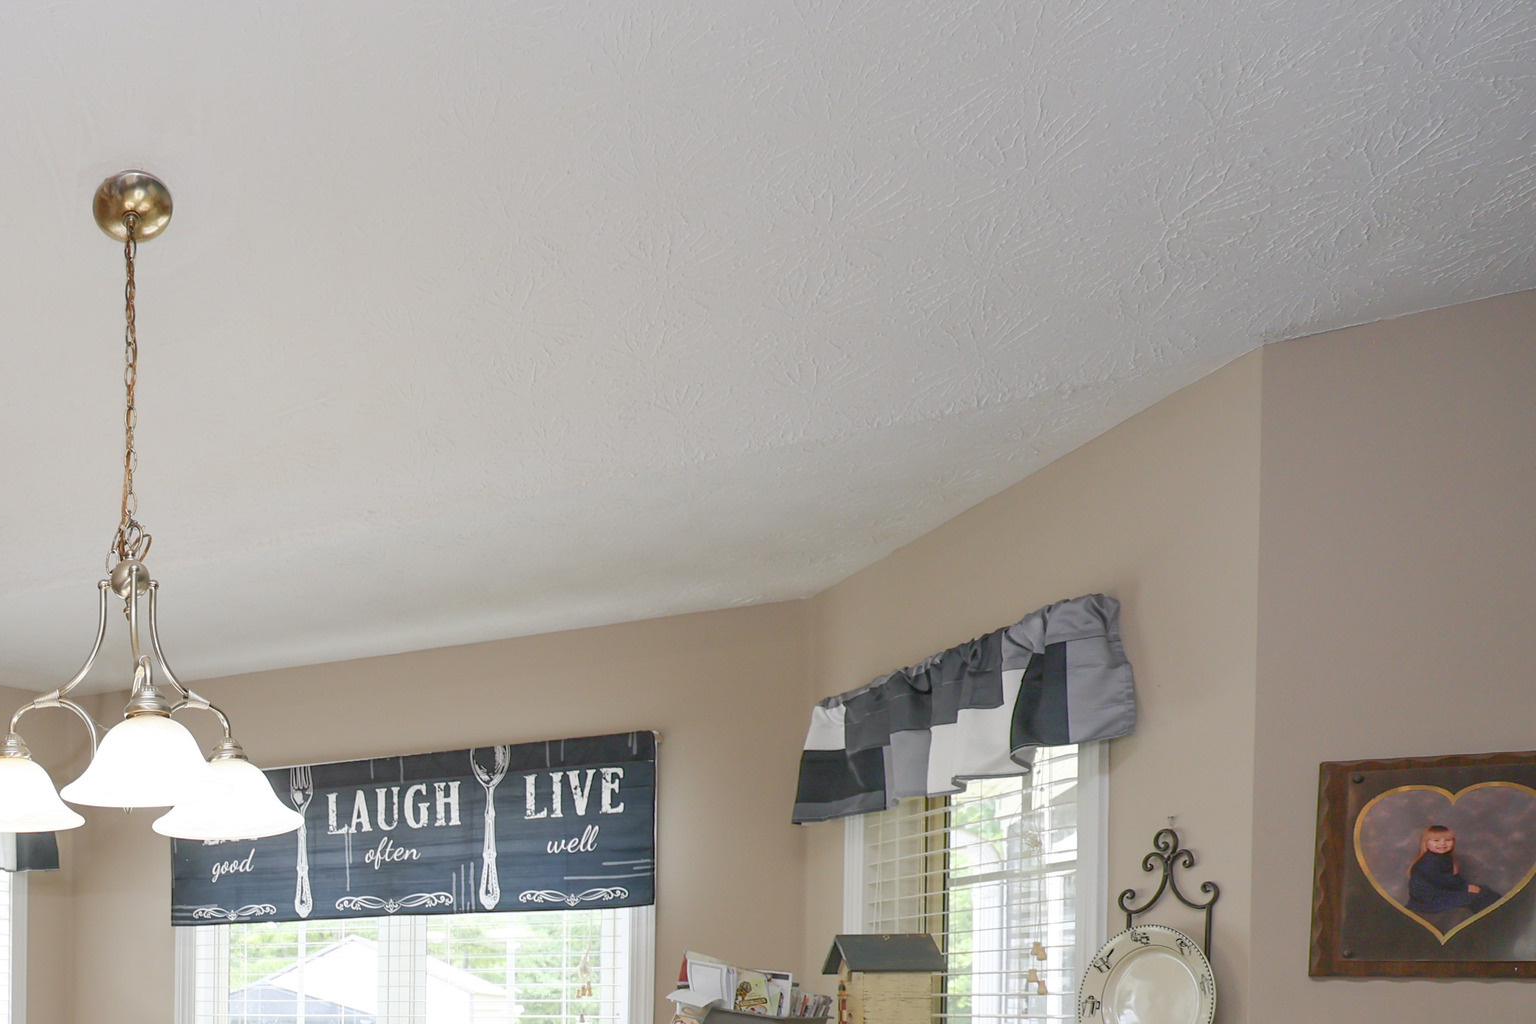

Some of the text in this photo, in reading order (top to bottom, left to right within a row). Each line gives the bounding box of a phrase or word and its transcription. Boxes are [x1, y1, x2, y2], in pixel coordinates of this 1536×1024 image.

[326, 767, 624, 834] LAUGH LIVE
[211, 824, 600, 883] good often well
